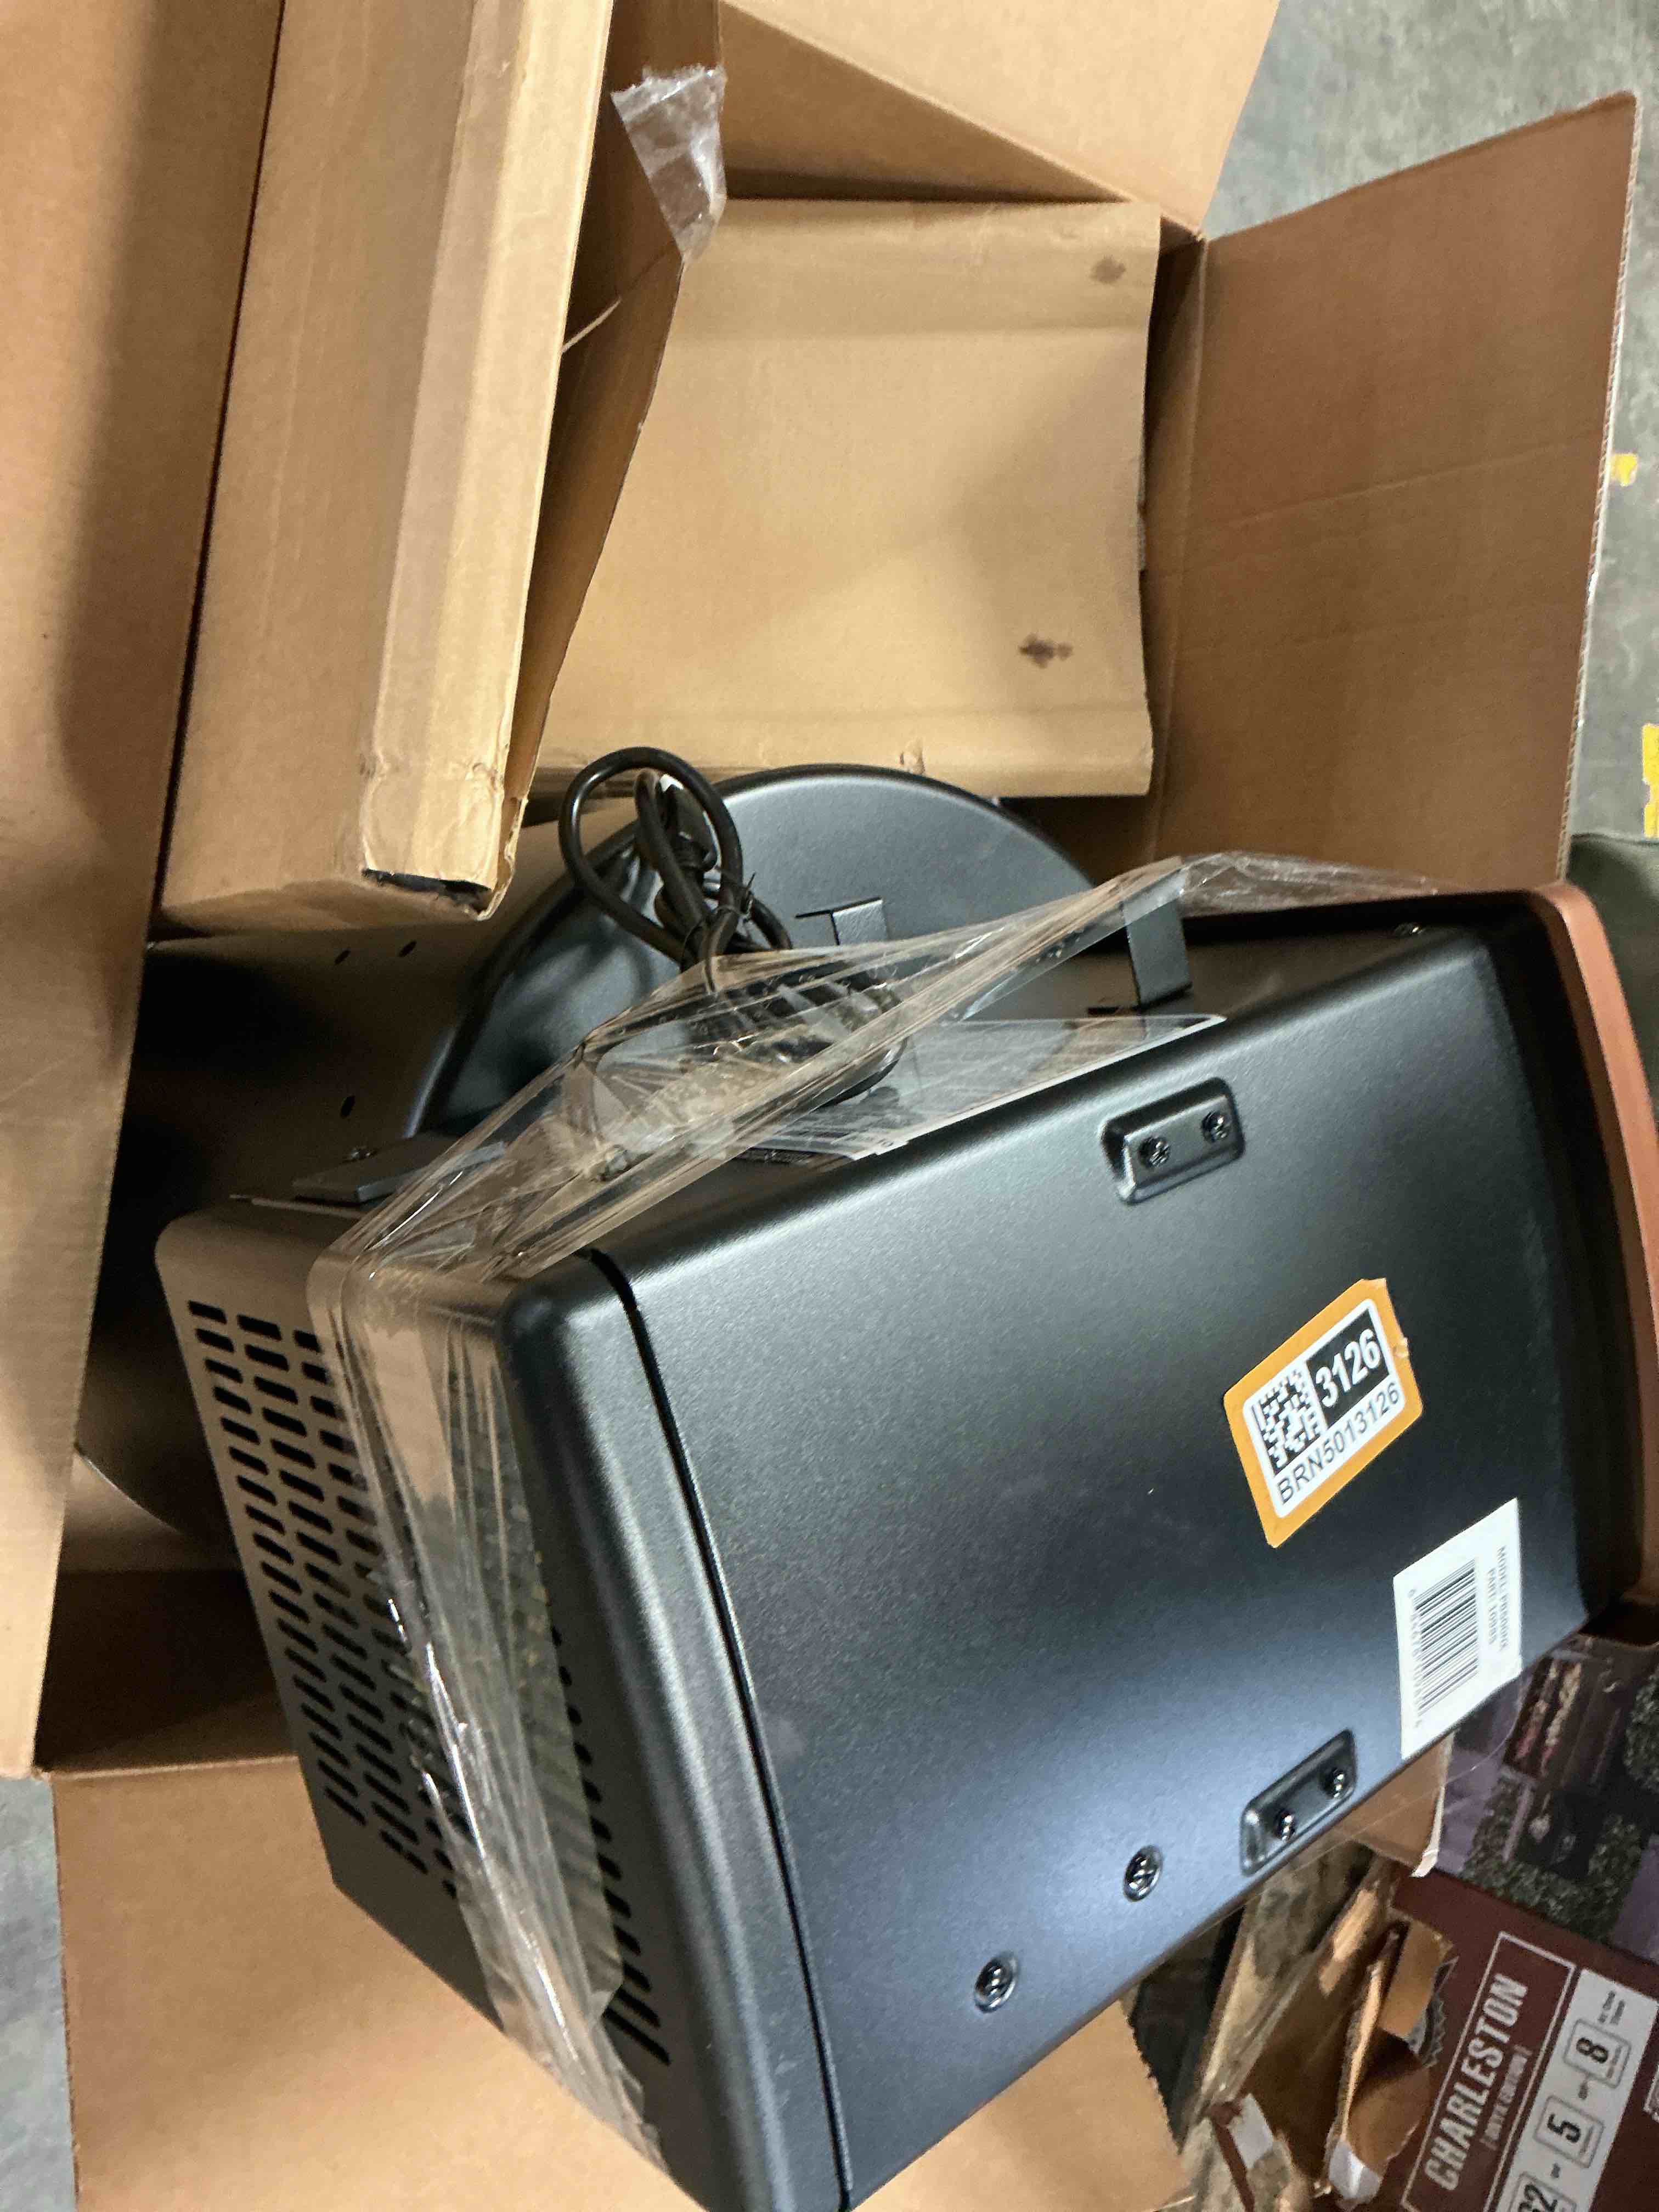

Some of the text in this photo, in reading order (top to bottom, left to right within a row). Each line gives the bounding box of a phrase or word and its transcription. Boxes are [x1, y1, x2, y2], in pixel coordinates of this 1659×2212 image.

[1315, 1329, 1382, 1408] 3126
[1277, 1382, 1400, 1504] BRN5013126
[1425, 1973, 1528, 2191] CHARLESTON
[1547, 2114, 1581, 2143] 5
[1576, 2036, 1609, 2064] 8
